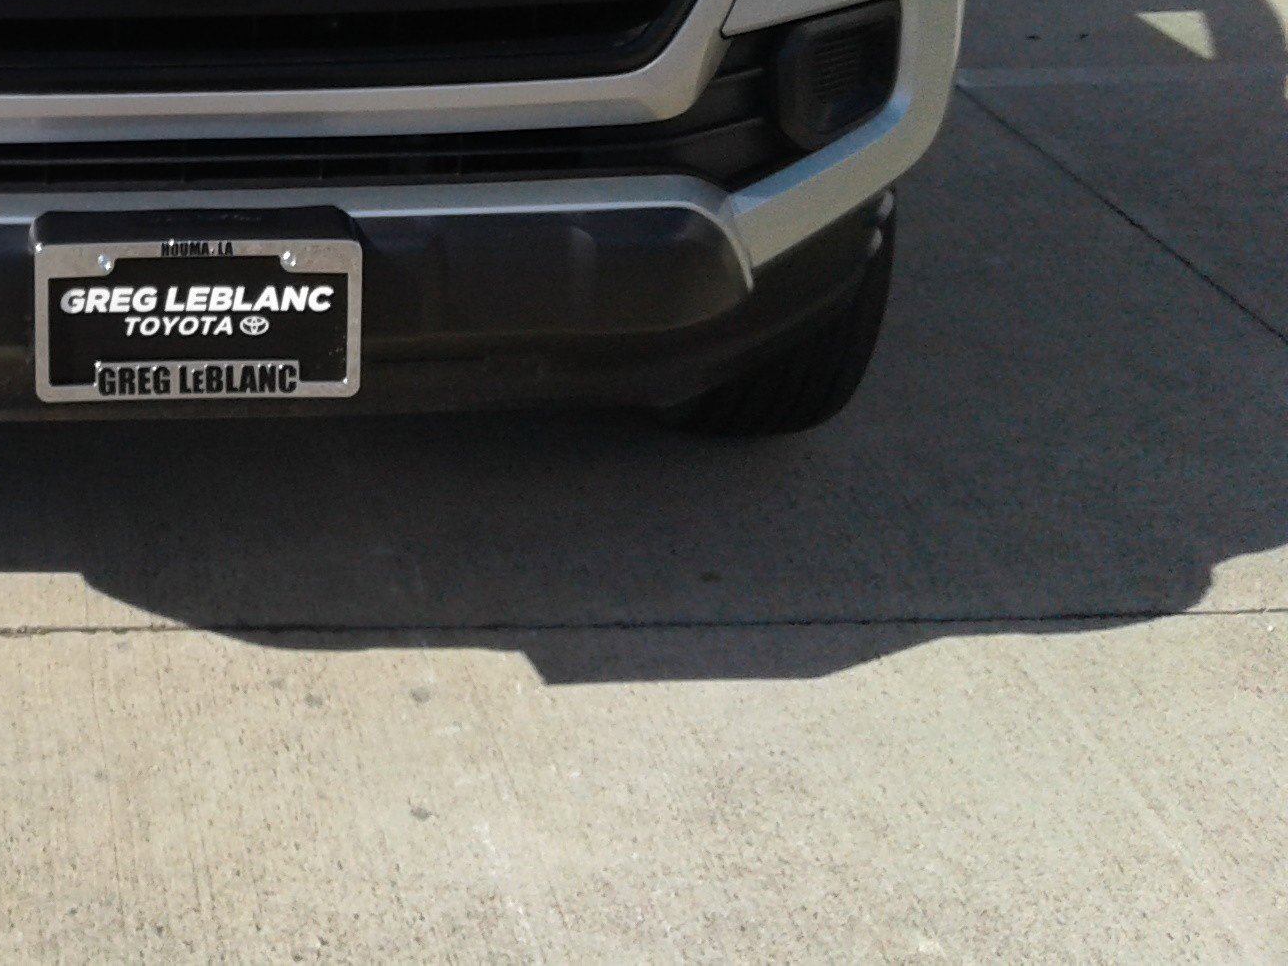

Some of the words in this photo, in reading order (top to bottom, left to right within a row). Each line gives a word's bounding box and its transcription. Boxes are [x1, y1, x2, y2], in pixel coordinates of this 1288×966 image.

[218, 242, 233, 256] LA
[60, 287, 158, 313] GREG
[164, 285, 334, 313] LEBLANC
[124, 316, 233, 336] TOYOTA
[99, 366, 171, 395] GREG
